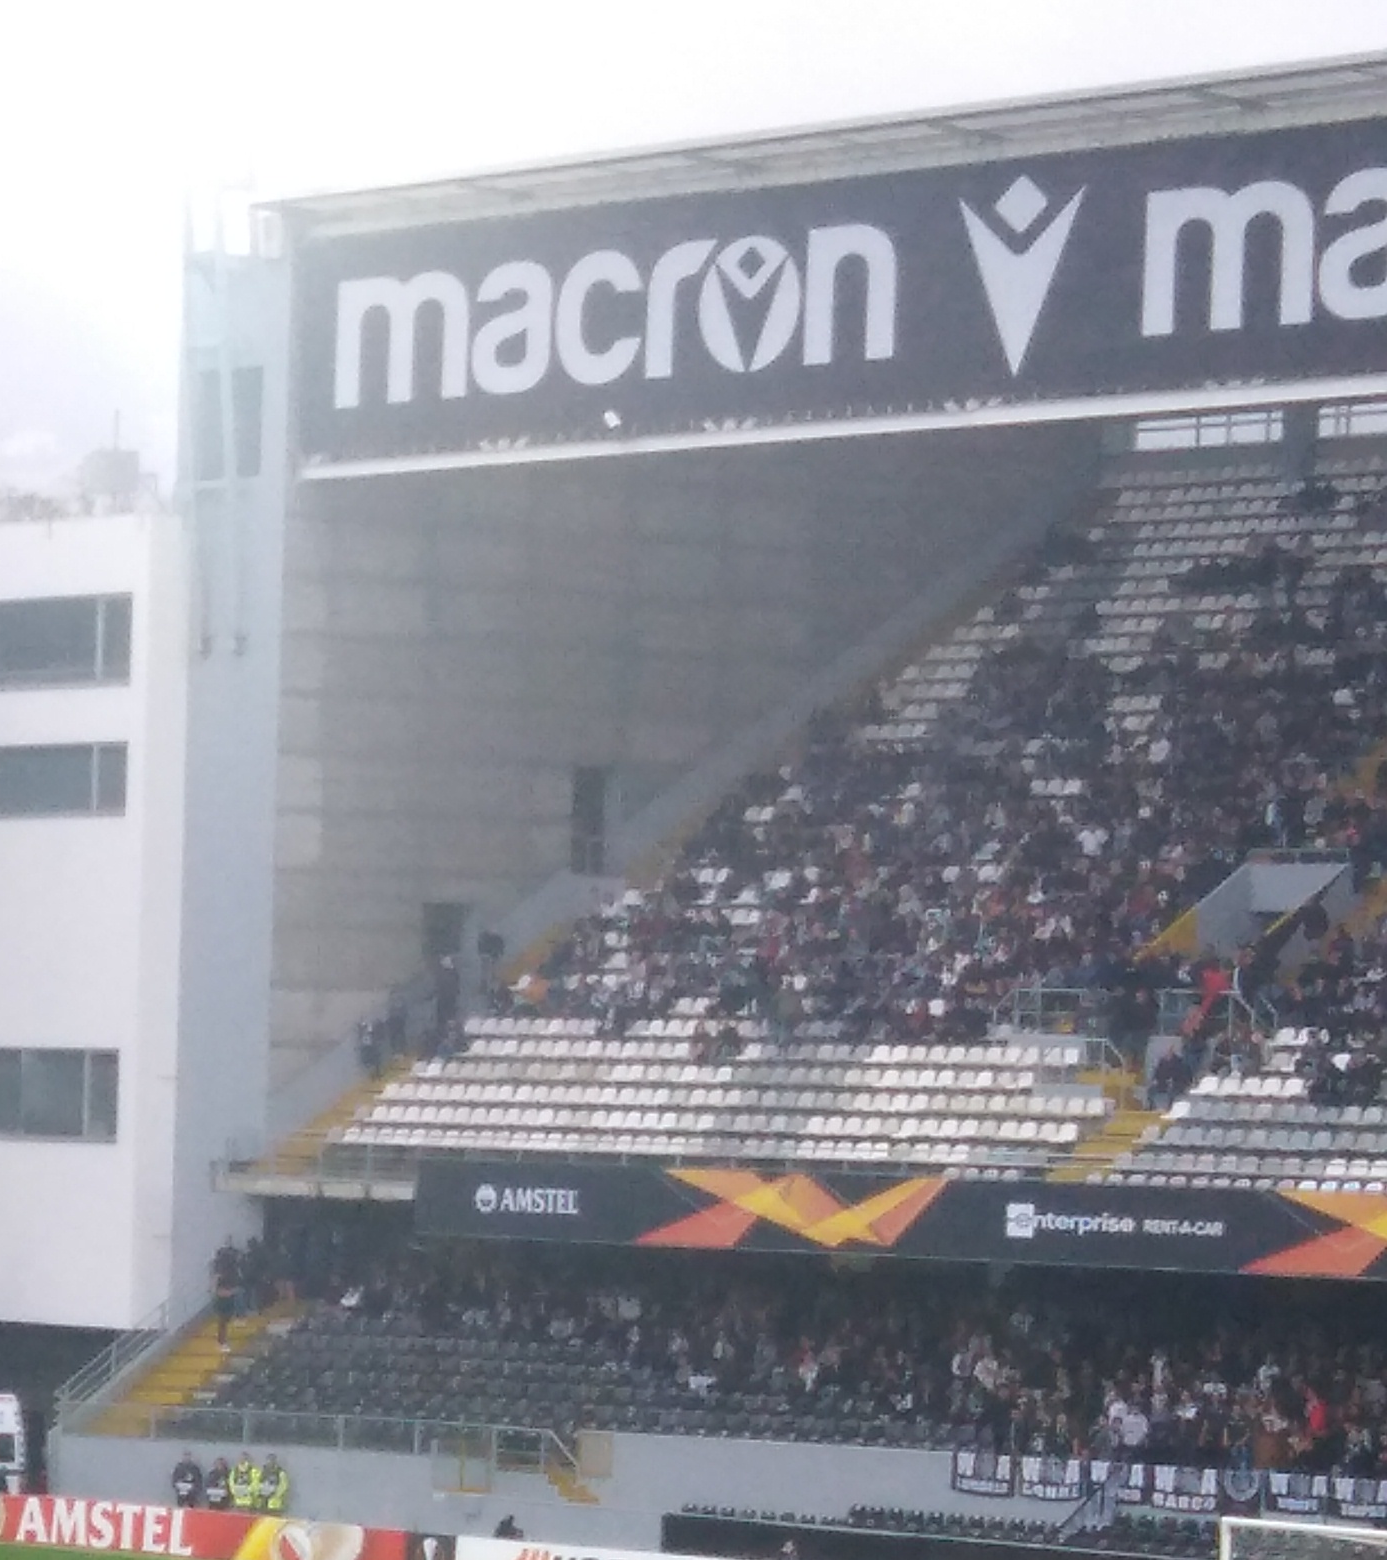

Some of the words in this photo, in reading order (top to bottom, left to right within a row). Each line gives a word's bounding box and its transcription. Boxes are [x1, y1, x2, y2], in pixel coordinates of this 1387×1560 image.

[334, 223, 896, 410] macron
[500, 1187, 579, 1214] AMSTEL
[16, 1497, 192, 1557] AMSTEL
